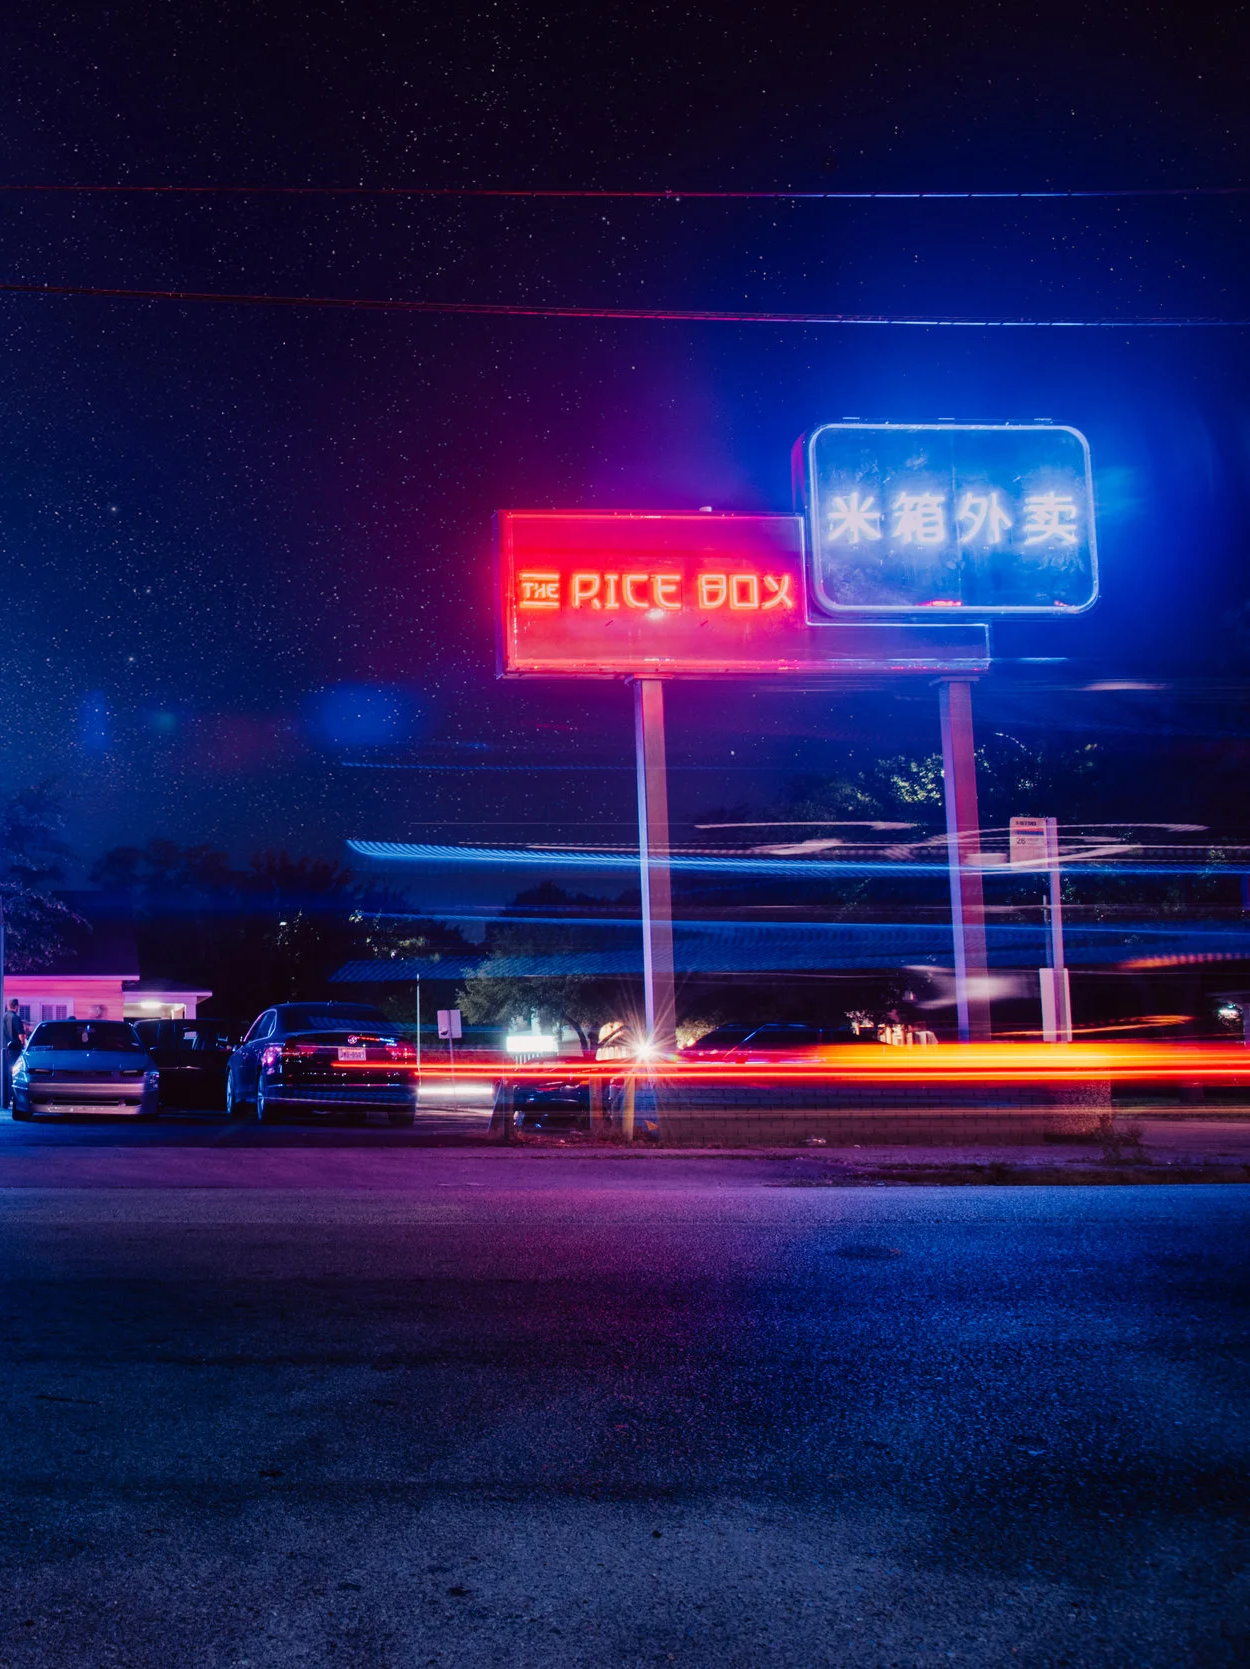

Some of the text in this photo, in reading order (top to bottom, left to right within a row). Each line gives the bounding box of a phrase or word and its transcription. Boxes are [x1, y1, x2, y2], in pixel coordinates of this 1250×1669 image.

[828, 492, 1077, 545] 米箱外卖
[521, 573, 793, 609] THE RICE BOX
